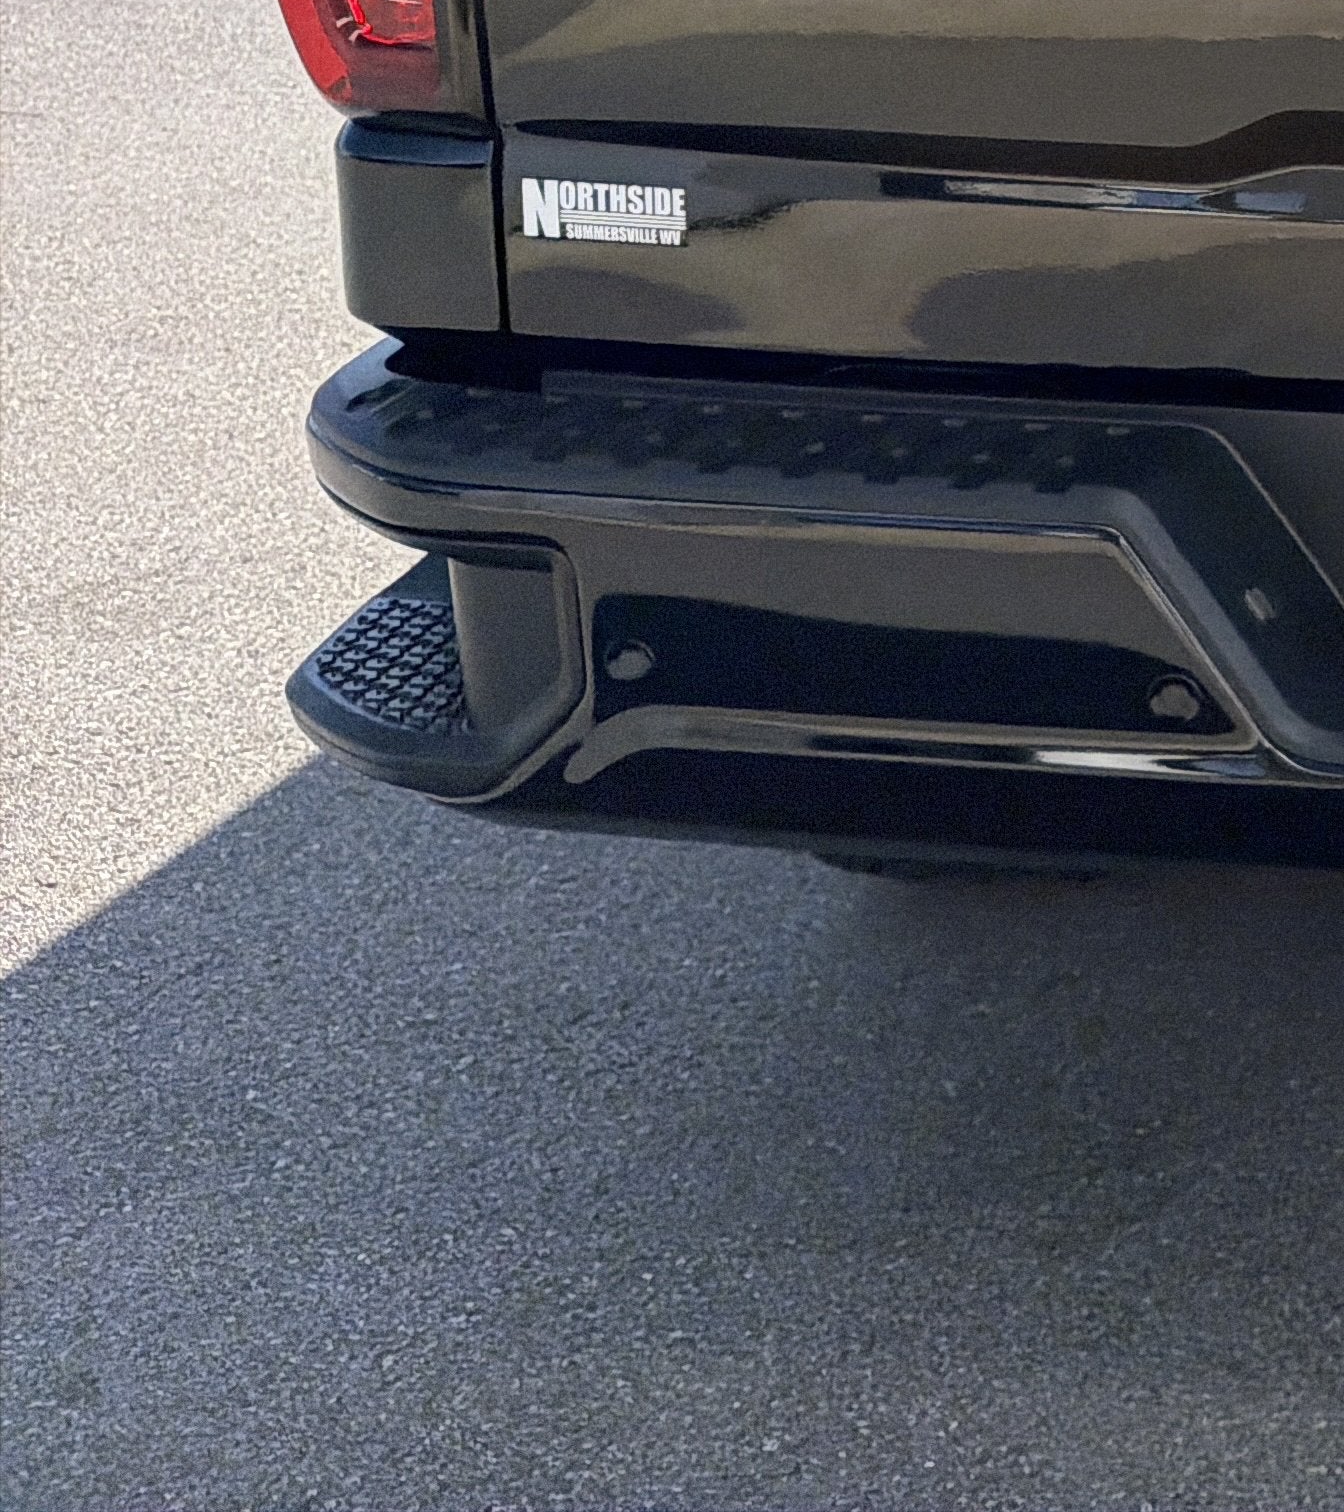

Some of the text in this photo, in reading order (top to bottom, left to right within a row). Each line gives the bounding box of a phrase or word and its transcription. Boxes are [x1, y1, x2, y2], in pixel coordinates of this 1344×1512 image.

[522, 178, 686, 238] NORTHSIDE
[566, 223, 681, 246] SUMMERSVILLE WV
